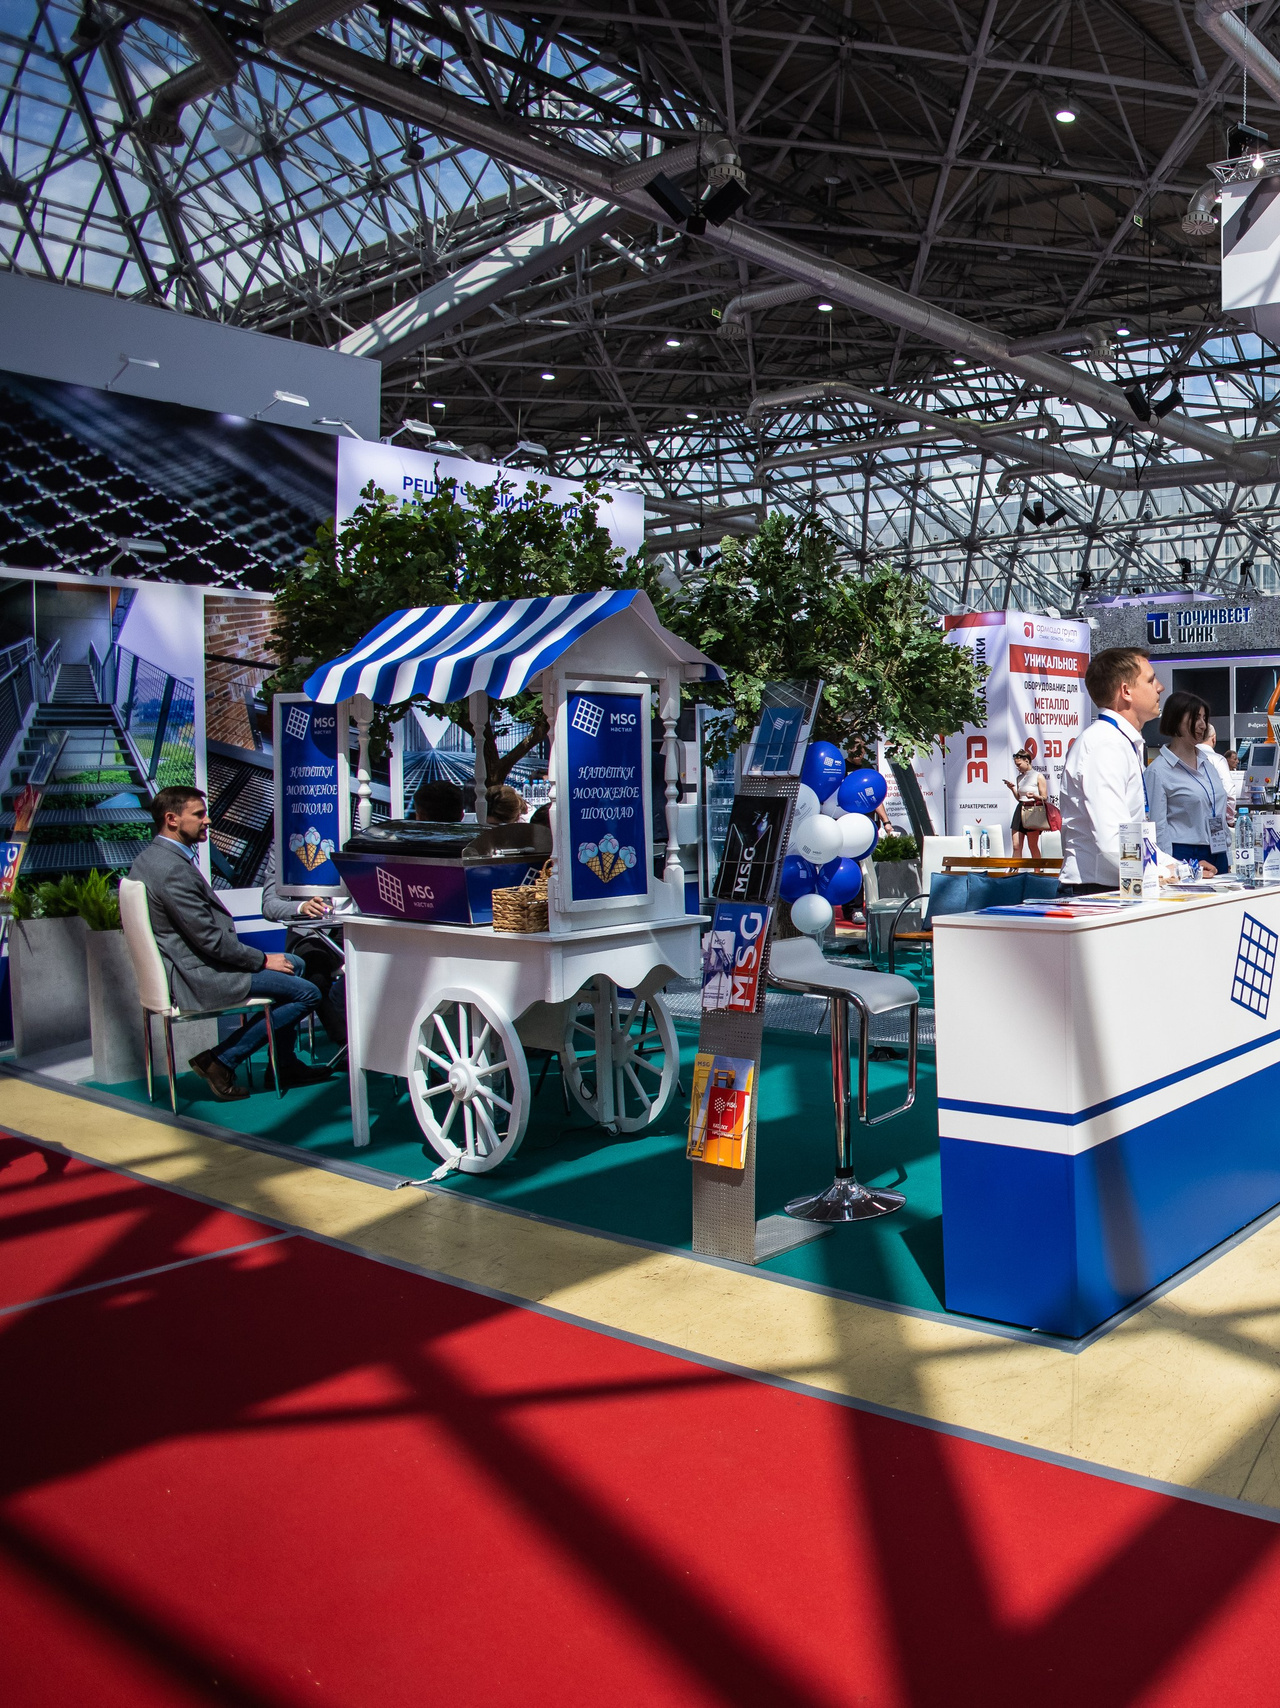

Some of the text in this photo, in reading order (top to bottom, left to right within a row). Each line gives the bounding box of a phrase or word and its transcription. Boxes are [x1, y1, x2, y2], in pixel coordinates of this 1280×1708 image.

[1176, 607, 1251, 626] ТОЧИНВЕСТ
[1178, 627, 1215, 644] ЦИНК
[1024, 652, 1078, 671] УНИКАЛЬНОЕ
[1024, 680, 1078, 694] ОБОРУДОВАНИЕ ДЛЯ
[1034, 697, 1070, 711] МЕТАЛЛО
[314, 717, 336, 728] MSG
[610, 713, 637, 726] MSG
[1024, 712, 1079, 727] КОНСТРУКЦИЙ
[1043, 740, 1063, 758] 3D
[966, 735, 989, 784] 3D
[289, 766, 334, 779] НАПИТКИ
[578, 766, 636, 781] НАПИТКИ
[286, 784, 338, 797] МОРОЖЕНОЕ
[573, 786, 640, 800] МОРОЖЕНОЕ
[291, 803, 334, 816] ШОКОЛАД
[580, 806, 635, 821] ШОКОЛАД
[734, 847, 756, 893] MSG
[407, 884, 435, 900] MSG
[733, 912, 762, 1007] MSG
